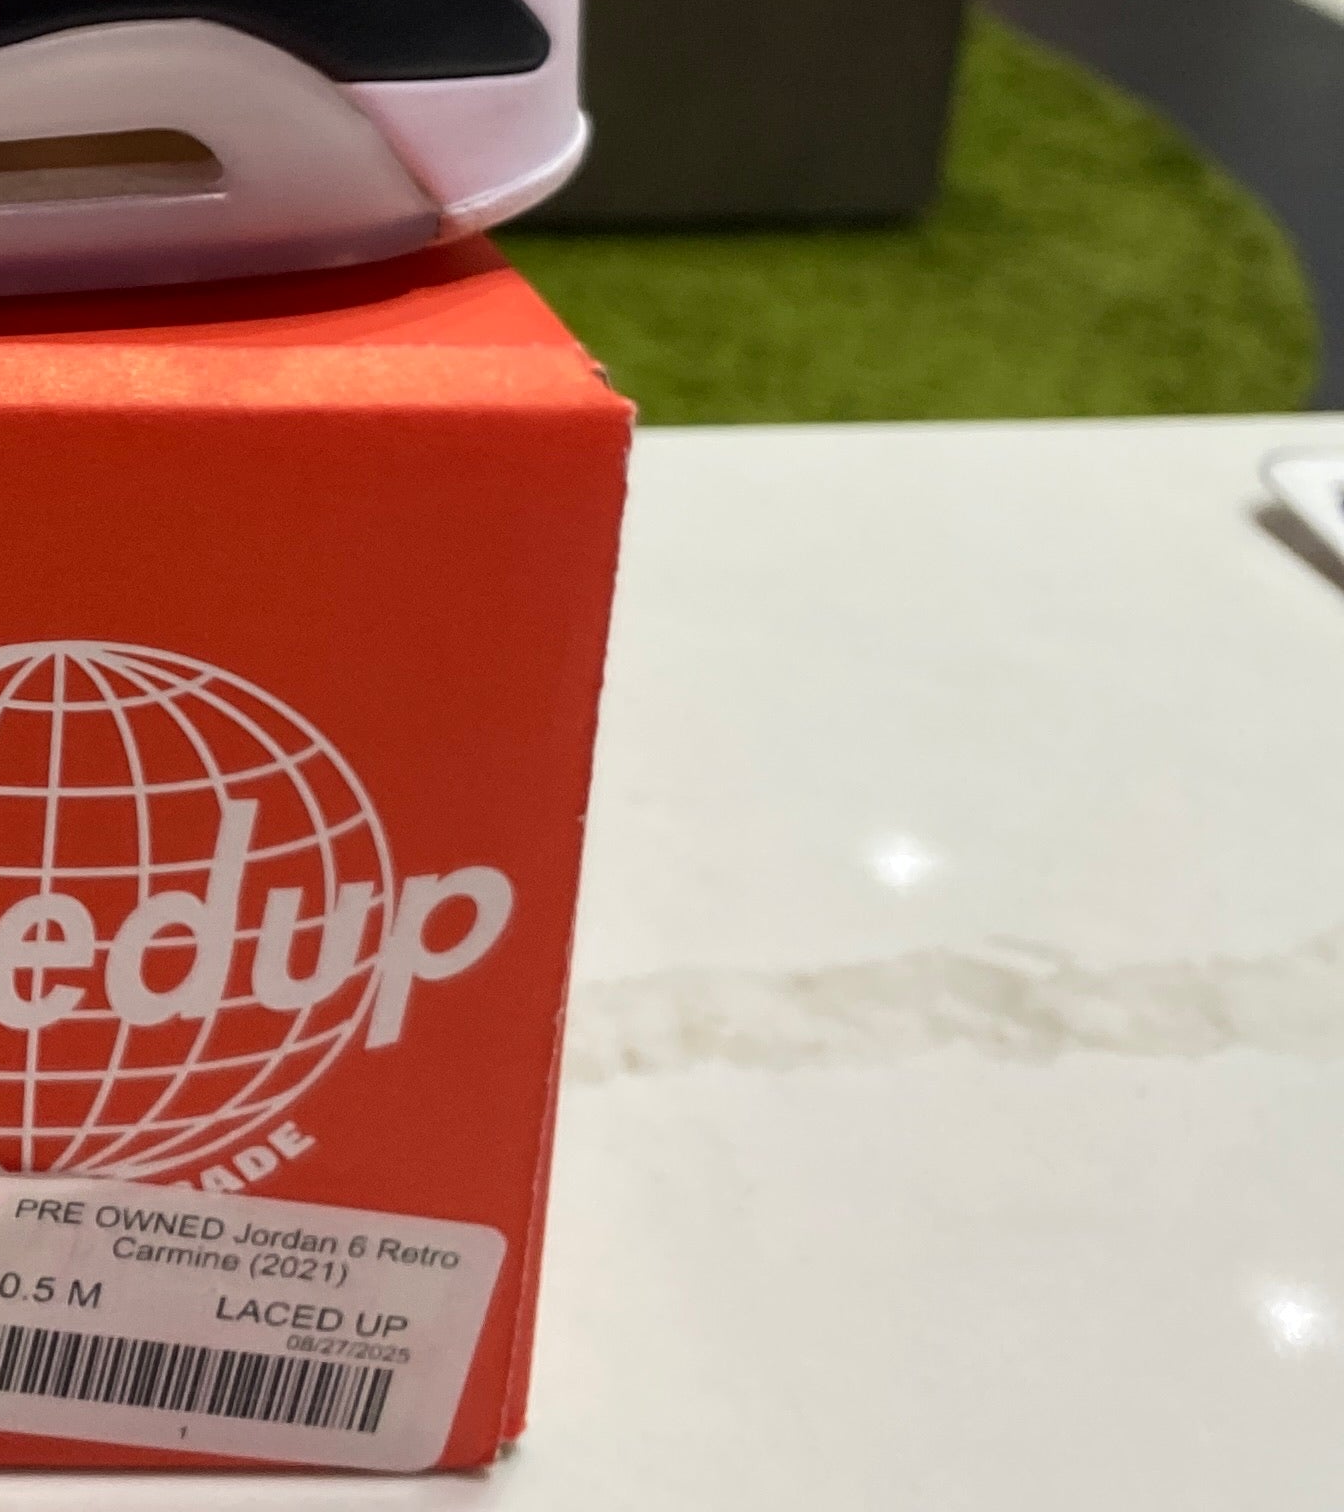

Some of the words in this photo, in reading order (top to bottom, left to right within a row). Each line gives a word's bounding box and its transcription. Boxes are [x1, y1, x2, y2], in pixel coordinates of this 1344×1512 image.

[168, 1120, 316, 1192] ADE
[15, 1198, 85, 1225] PRE
[95, 1205, 225, 1241] OWNED
[233, 1222, 338, 1255] Jordan
[347, 1235, 368, 1259] 6
[377, 1238, 461, 1270] Retro
[112, 1236, 241, 1272] Carmine
[249, 1252, 349, 1288] (2021)
[67, 1279, 103, 1309] M
[216, 1295, 344, 1333] LACED
[355, 1311, 409, 1339] UP
